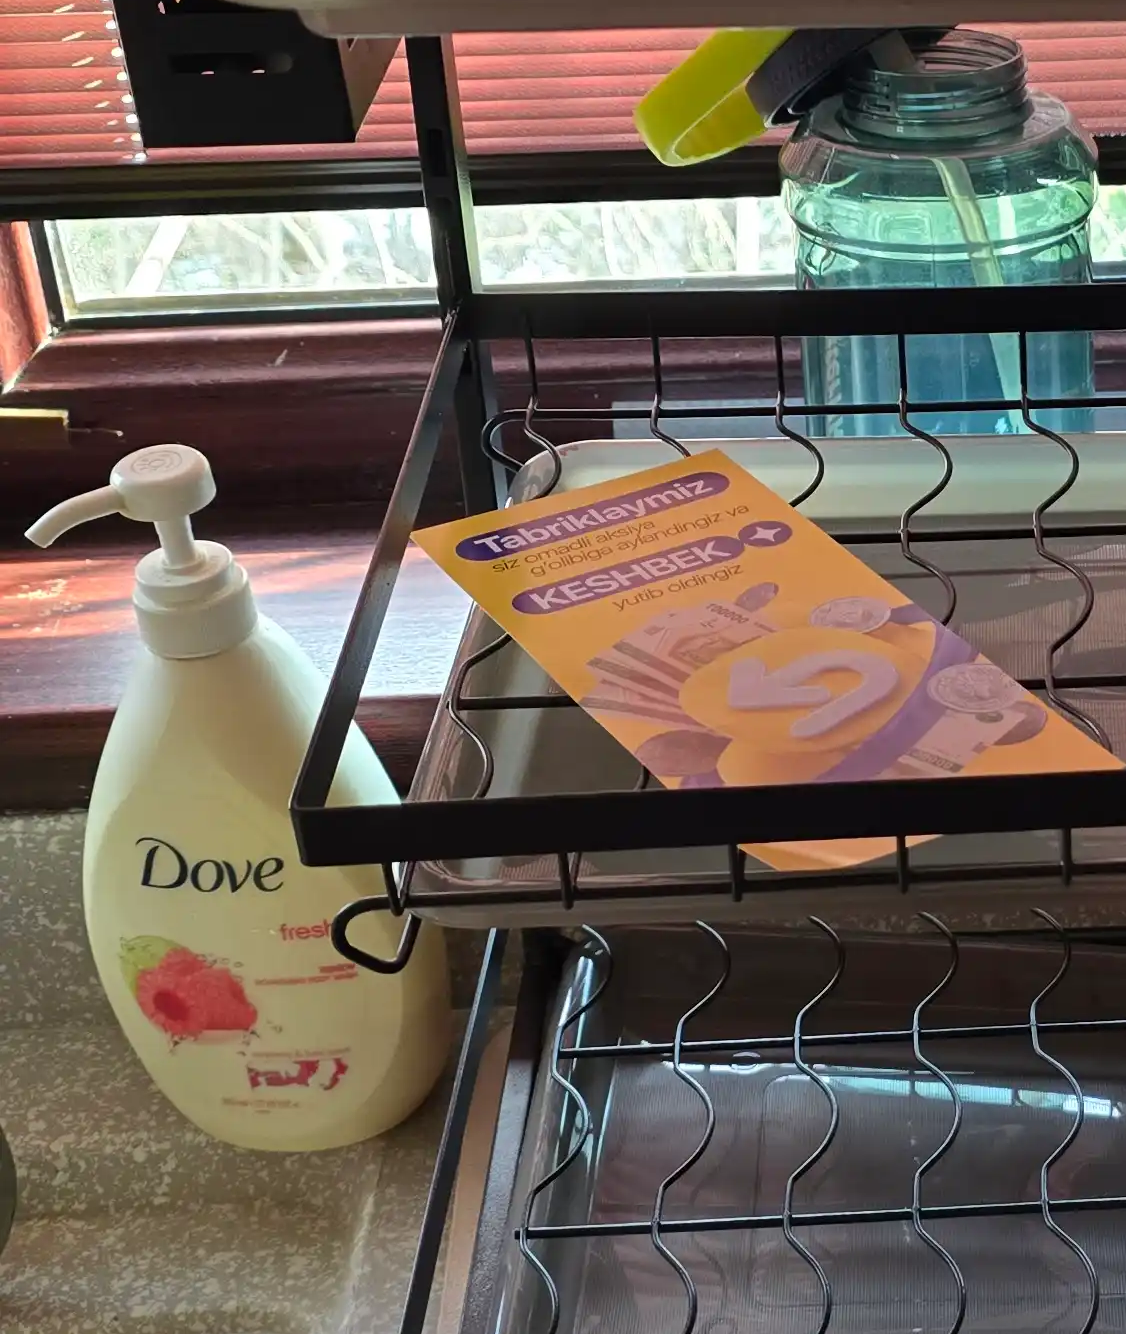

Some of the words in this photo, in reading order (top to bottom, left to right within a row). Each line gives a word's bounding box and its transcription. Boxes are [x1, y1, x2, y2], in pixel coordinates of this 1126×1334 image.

[474, 479, 713, 553] Tabriklaymiz
[618, 511, 721, 551] aylandingiz
[724, 504, 750, 521] va
[492, 556, 521, 573] siz
[525, 534, 593, 565] omadli
[596, 519, 655, 545] aksiya
[529, 541, 732, 611] KESHBEK
[612, 586, 664, 611] yutib
[668, 565, 744, 595] oldingiz
[135, 837, 284, 893] Dove
